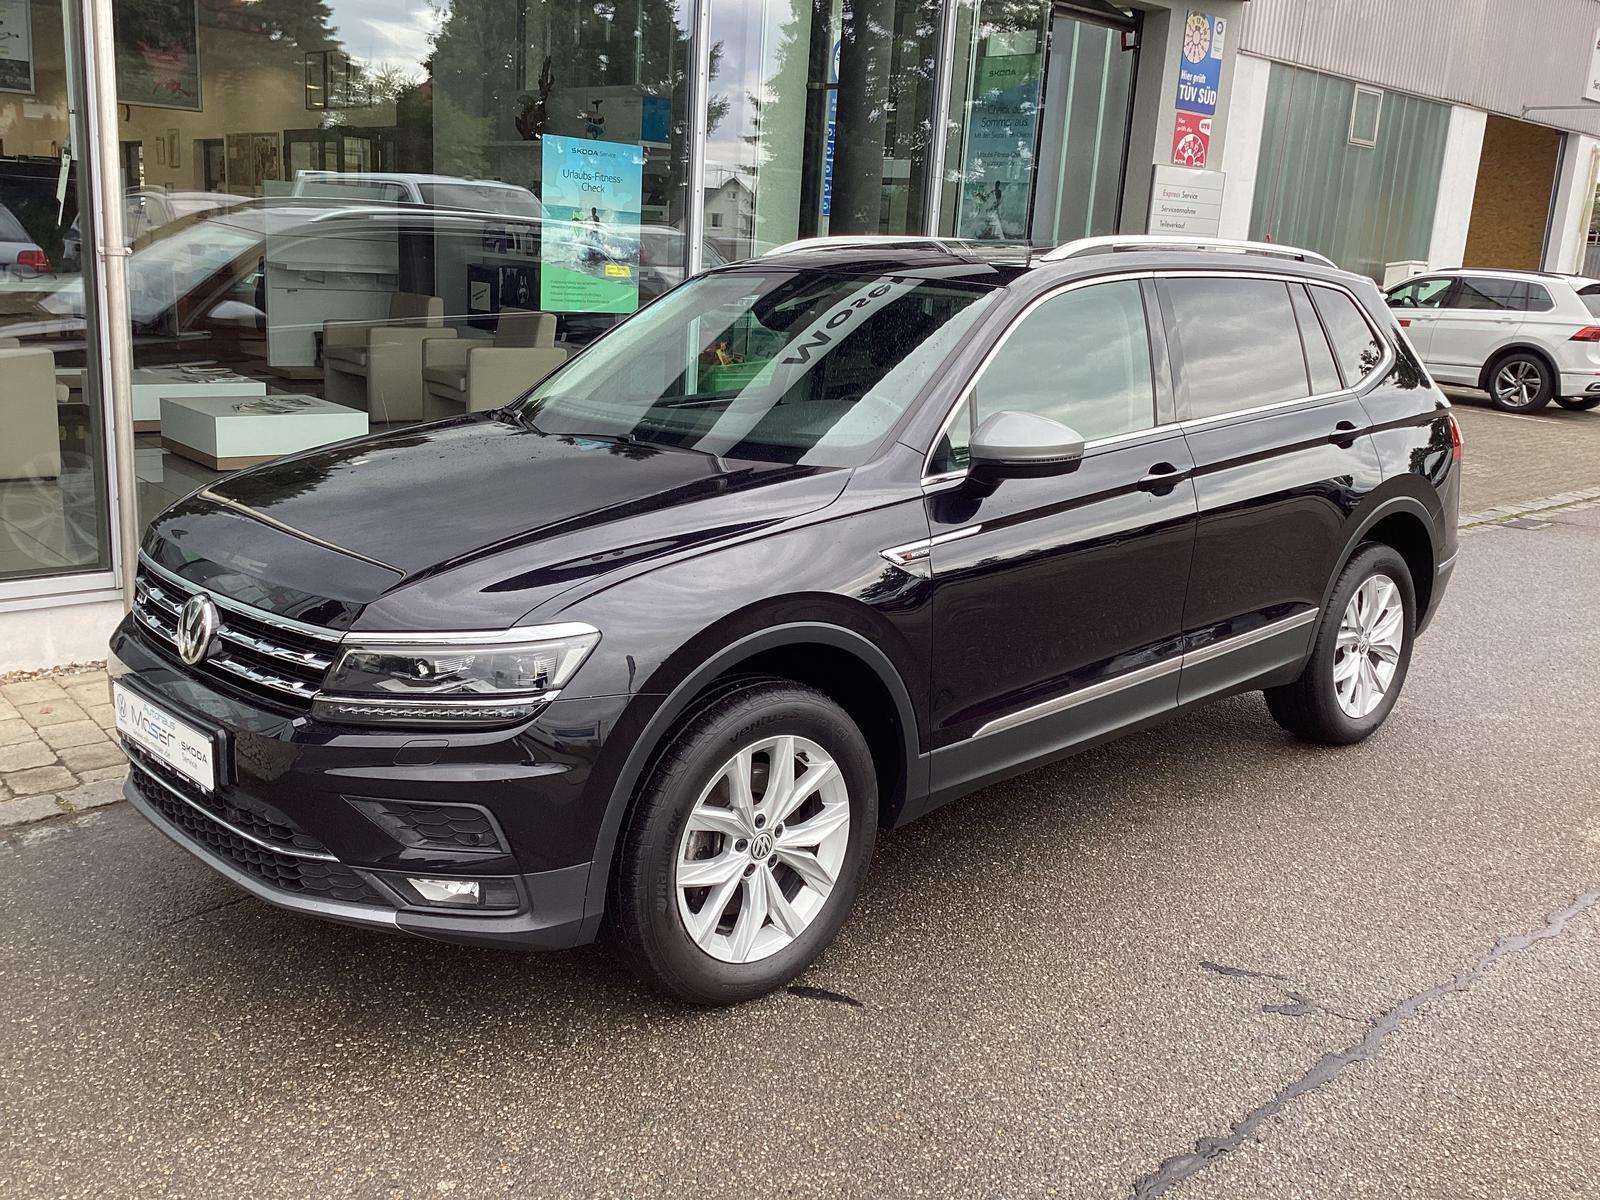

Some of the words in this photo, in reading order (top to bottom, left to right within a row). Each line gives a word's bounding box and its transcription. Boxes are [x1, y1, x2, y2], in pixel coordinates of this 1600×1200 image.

[1180, 69, 1193, 81] Hier
[1179, 82, 1198, 102] TÜV
[1197, 86, 1217, 105] SÜD
[562, 168, 624, 184] Urlaubs-Fitness-
[581, 182, 605, 193] Check
[1162, 189, 1180, 199] Express
[1181, 190, 1199, 200] Service
[1161, 204, 1196, 214] Serviceannahme
[1160, 220, 1186, 229] Teileverkauf
